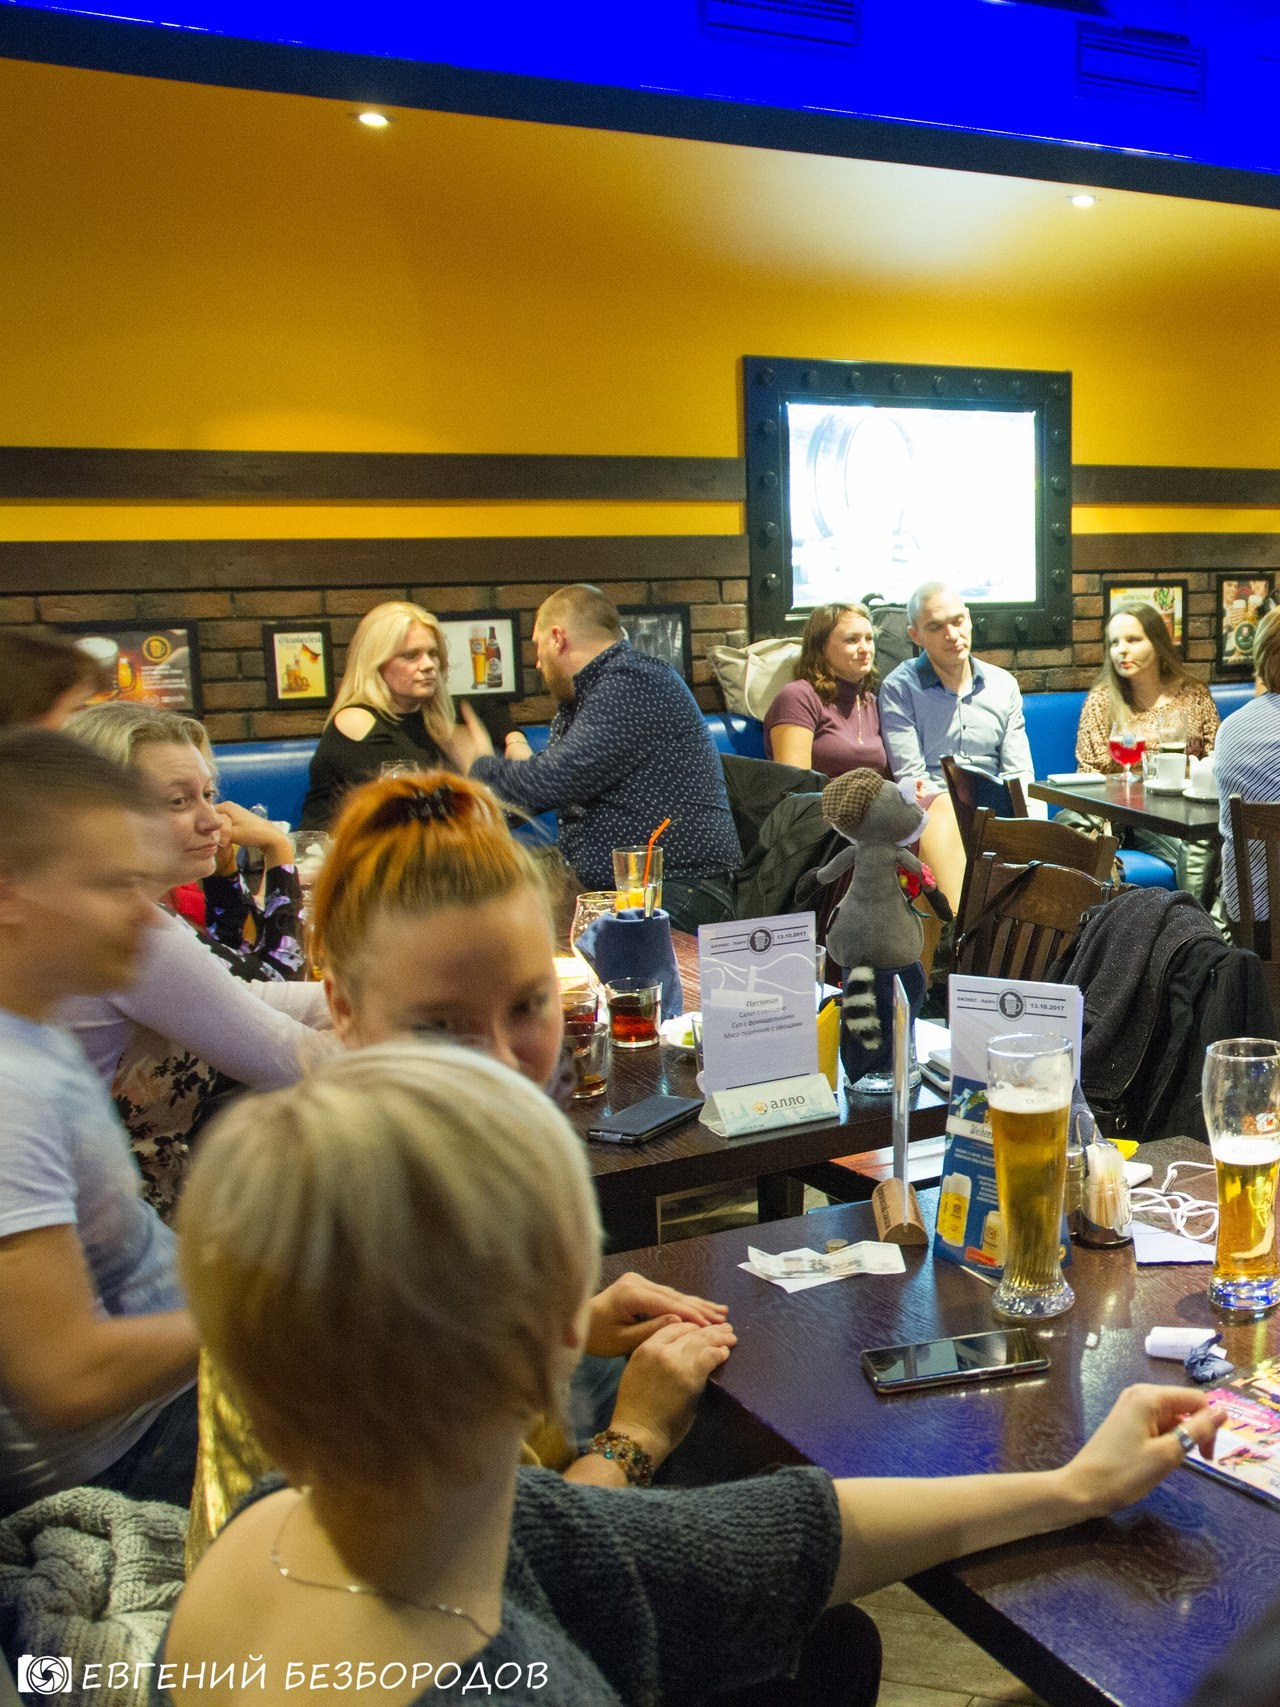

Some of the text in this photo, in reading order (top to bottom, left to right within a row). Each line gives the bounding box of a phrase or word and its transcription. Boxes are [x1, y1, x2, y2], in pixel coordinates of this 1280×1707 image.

[776, 931, 807, 940] 13.10.2017
[746, 997, 779, 1008] Пятница
[1030, 1003, 1065, 1012] 13.10.2017
[739, 1010, 756, 1018] Салат
[731, 1020, 743, 1029] Суп
[723, 1029, 740, 1039] Мясо
[776, 1021, 803, 1032] овощами
[770, 1094, 806, 1110] алло
